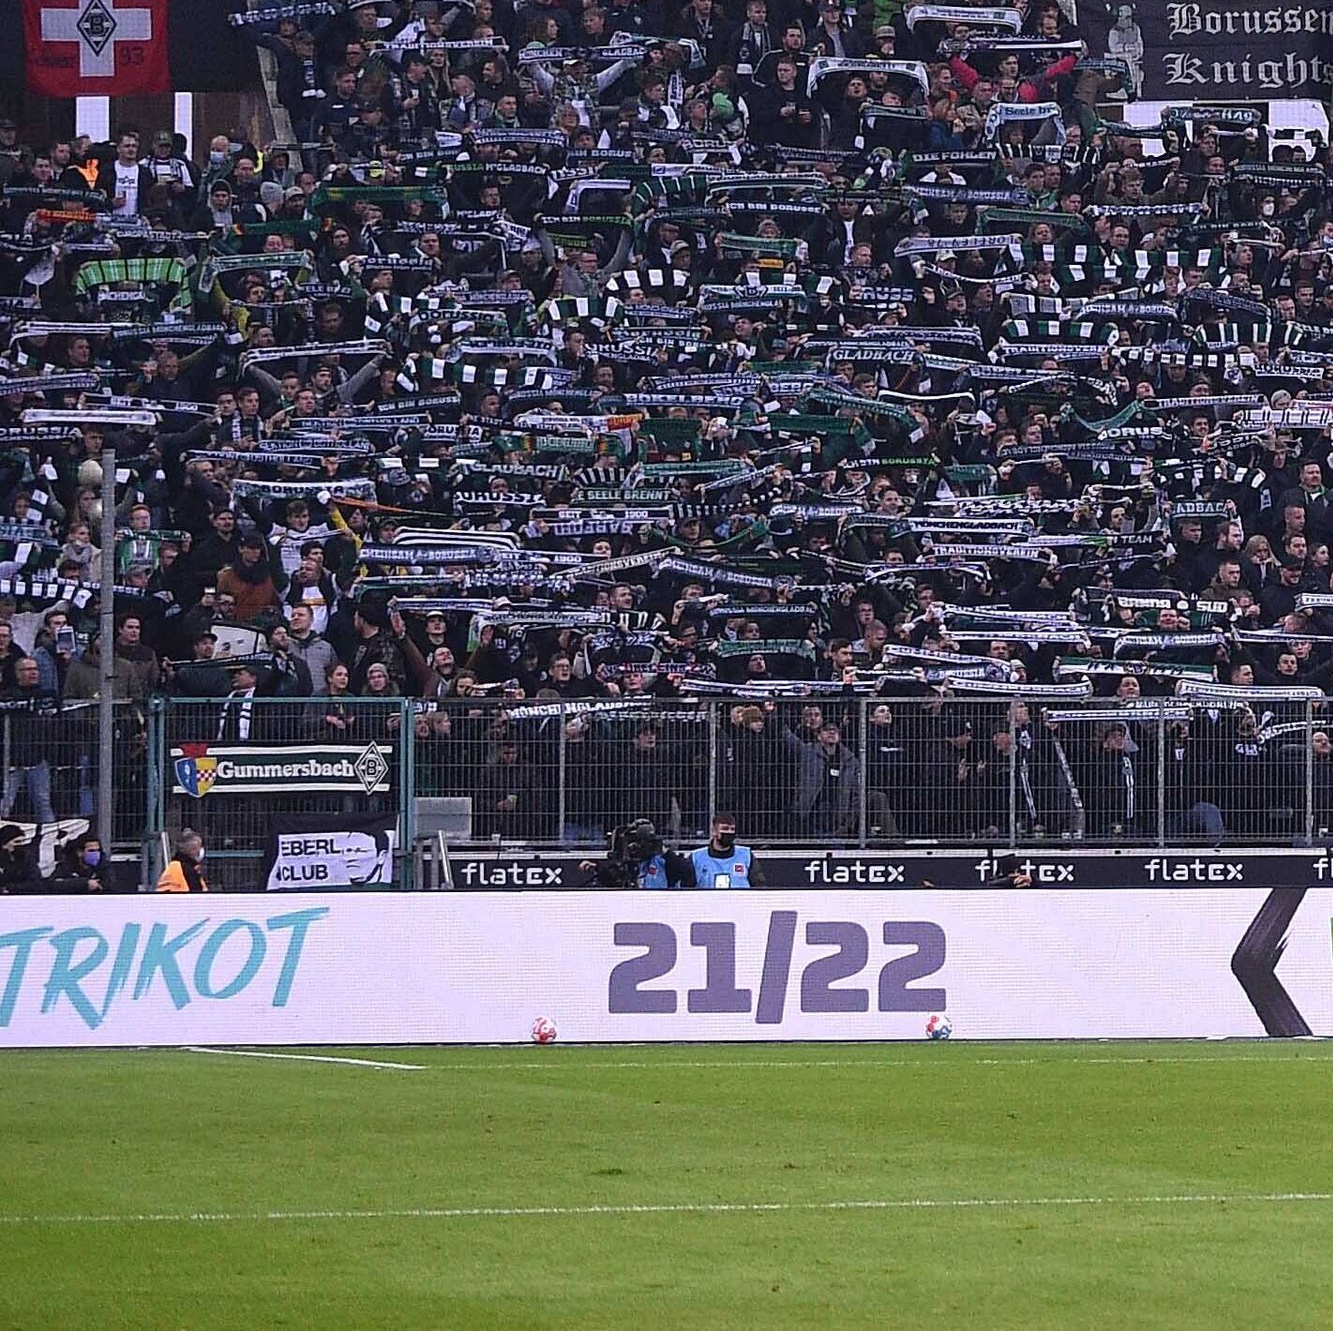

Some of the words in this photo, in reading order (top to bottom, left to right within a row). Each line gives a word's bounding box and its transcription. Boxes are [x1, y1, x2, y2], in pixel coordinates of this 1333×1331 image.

[1162, 53, 1333, 89] Knights
[912, 153, 940, 162] DIE
[942, 150, 998, 161] FOHLEN
[832, 349, 915, 361] GLADBACH
[587, 489, 622, 500] SEELE
[624, 490, 671, 500] BRENNT
[558, 509, 581, 519] SEIT
[624, 509, 649, 519] 1900
[1123, 534, 1153, 545] TEAM
[554, 554, 583, 564] 1900
[1196, 601, 1228, 613] SUD
[216, 761, 356, 779] Gummersbach
[281, 838, 340, 856] EBERL
[461, 861, 564, 886] flatex
[805, 858, 906, 884] flatex
[975, 858, 1075, 884] fltex
[1145, 858, 1244, 882] flatex
[0, 907, 330, 1030] TRIKOT
[609, 910, 947, 1024] 21/22
